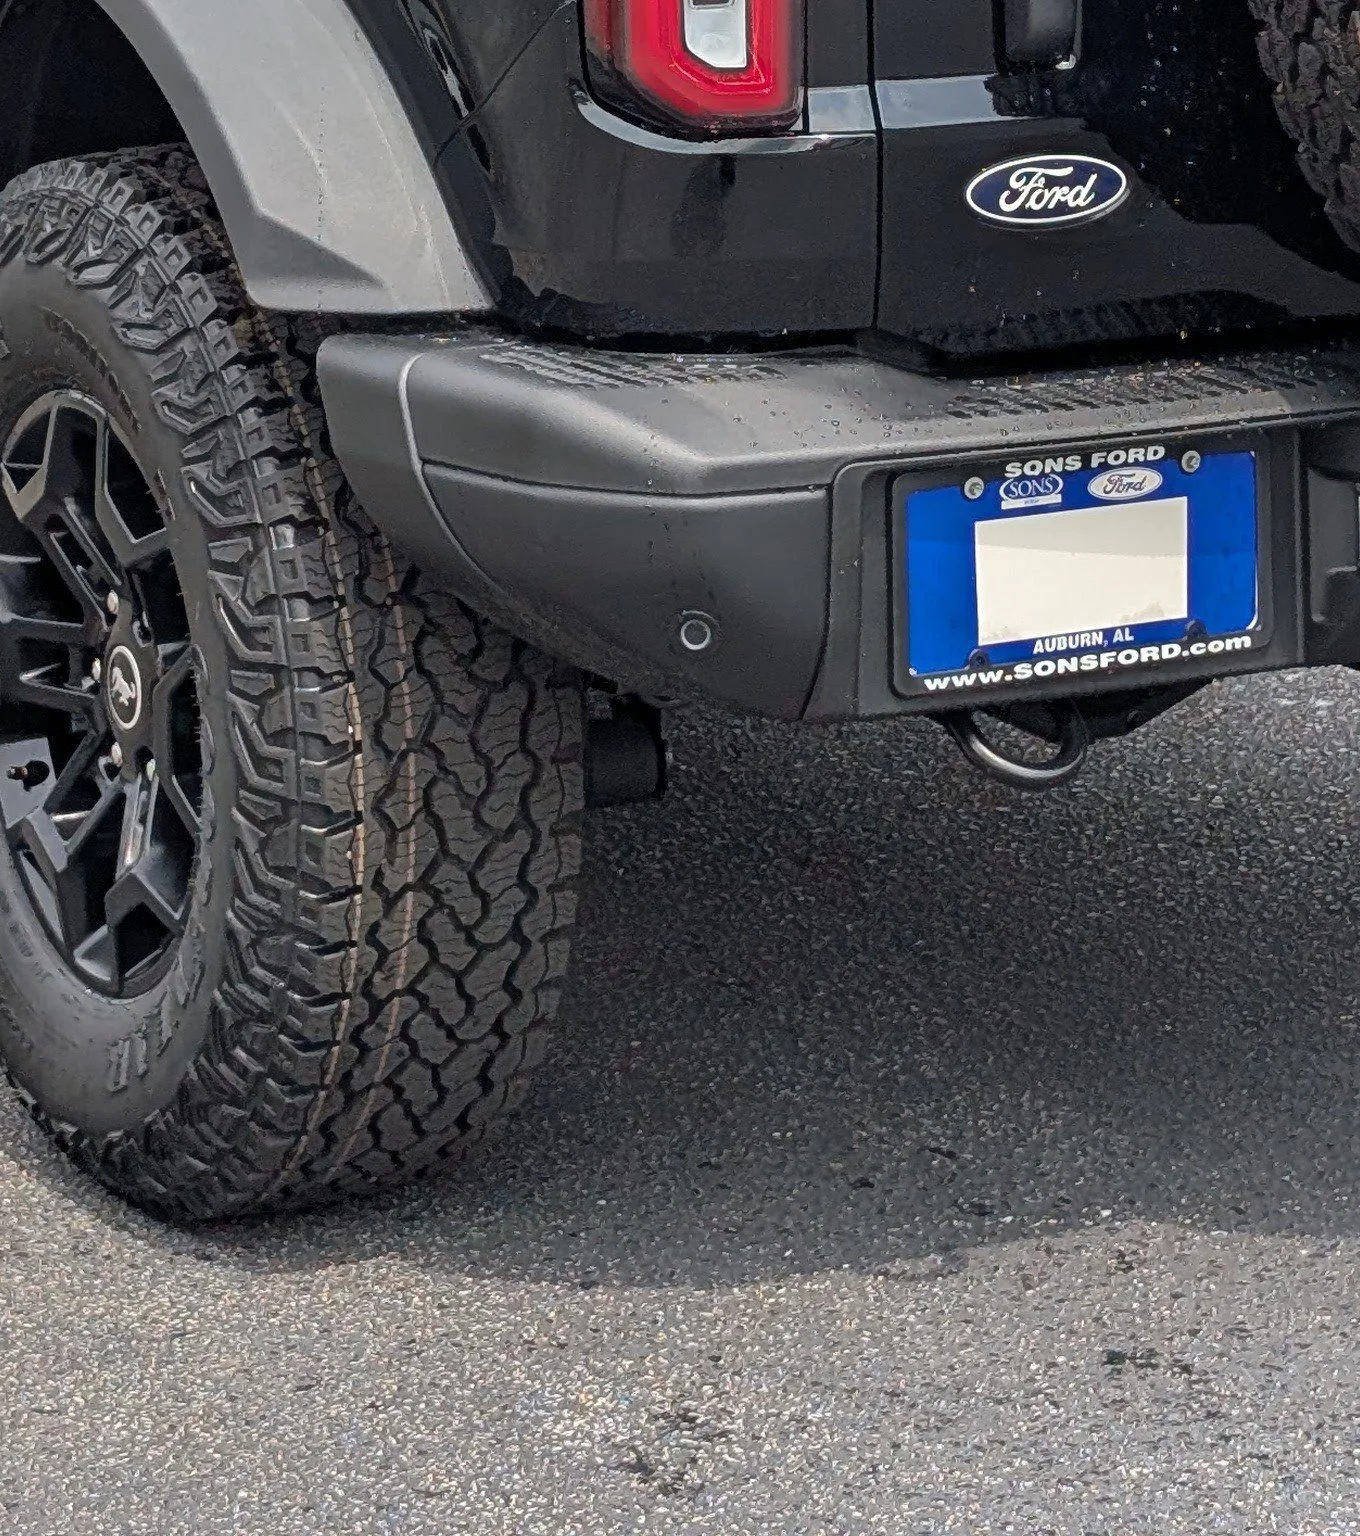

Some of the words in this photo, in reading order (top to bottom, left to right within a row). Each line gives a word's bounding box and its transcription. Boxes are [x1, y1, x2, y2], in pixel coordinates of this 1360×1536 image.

[1004, 454, 1083, 478] SONS
[1090, 445, 1166, 468] FORD
[1008, 476, 1055, 500] SONS
[1032, 629, 1109, 655] AUBURN,
[1113, 626, 1135, 643] AL
[923, 634, 1253, 691] www.SONSFORD.com
